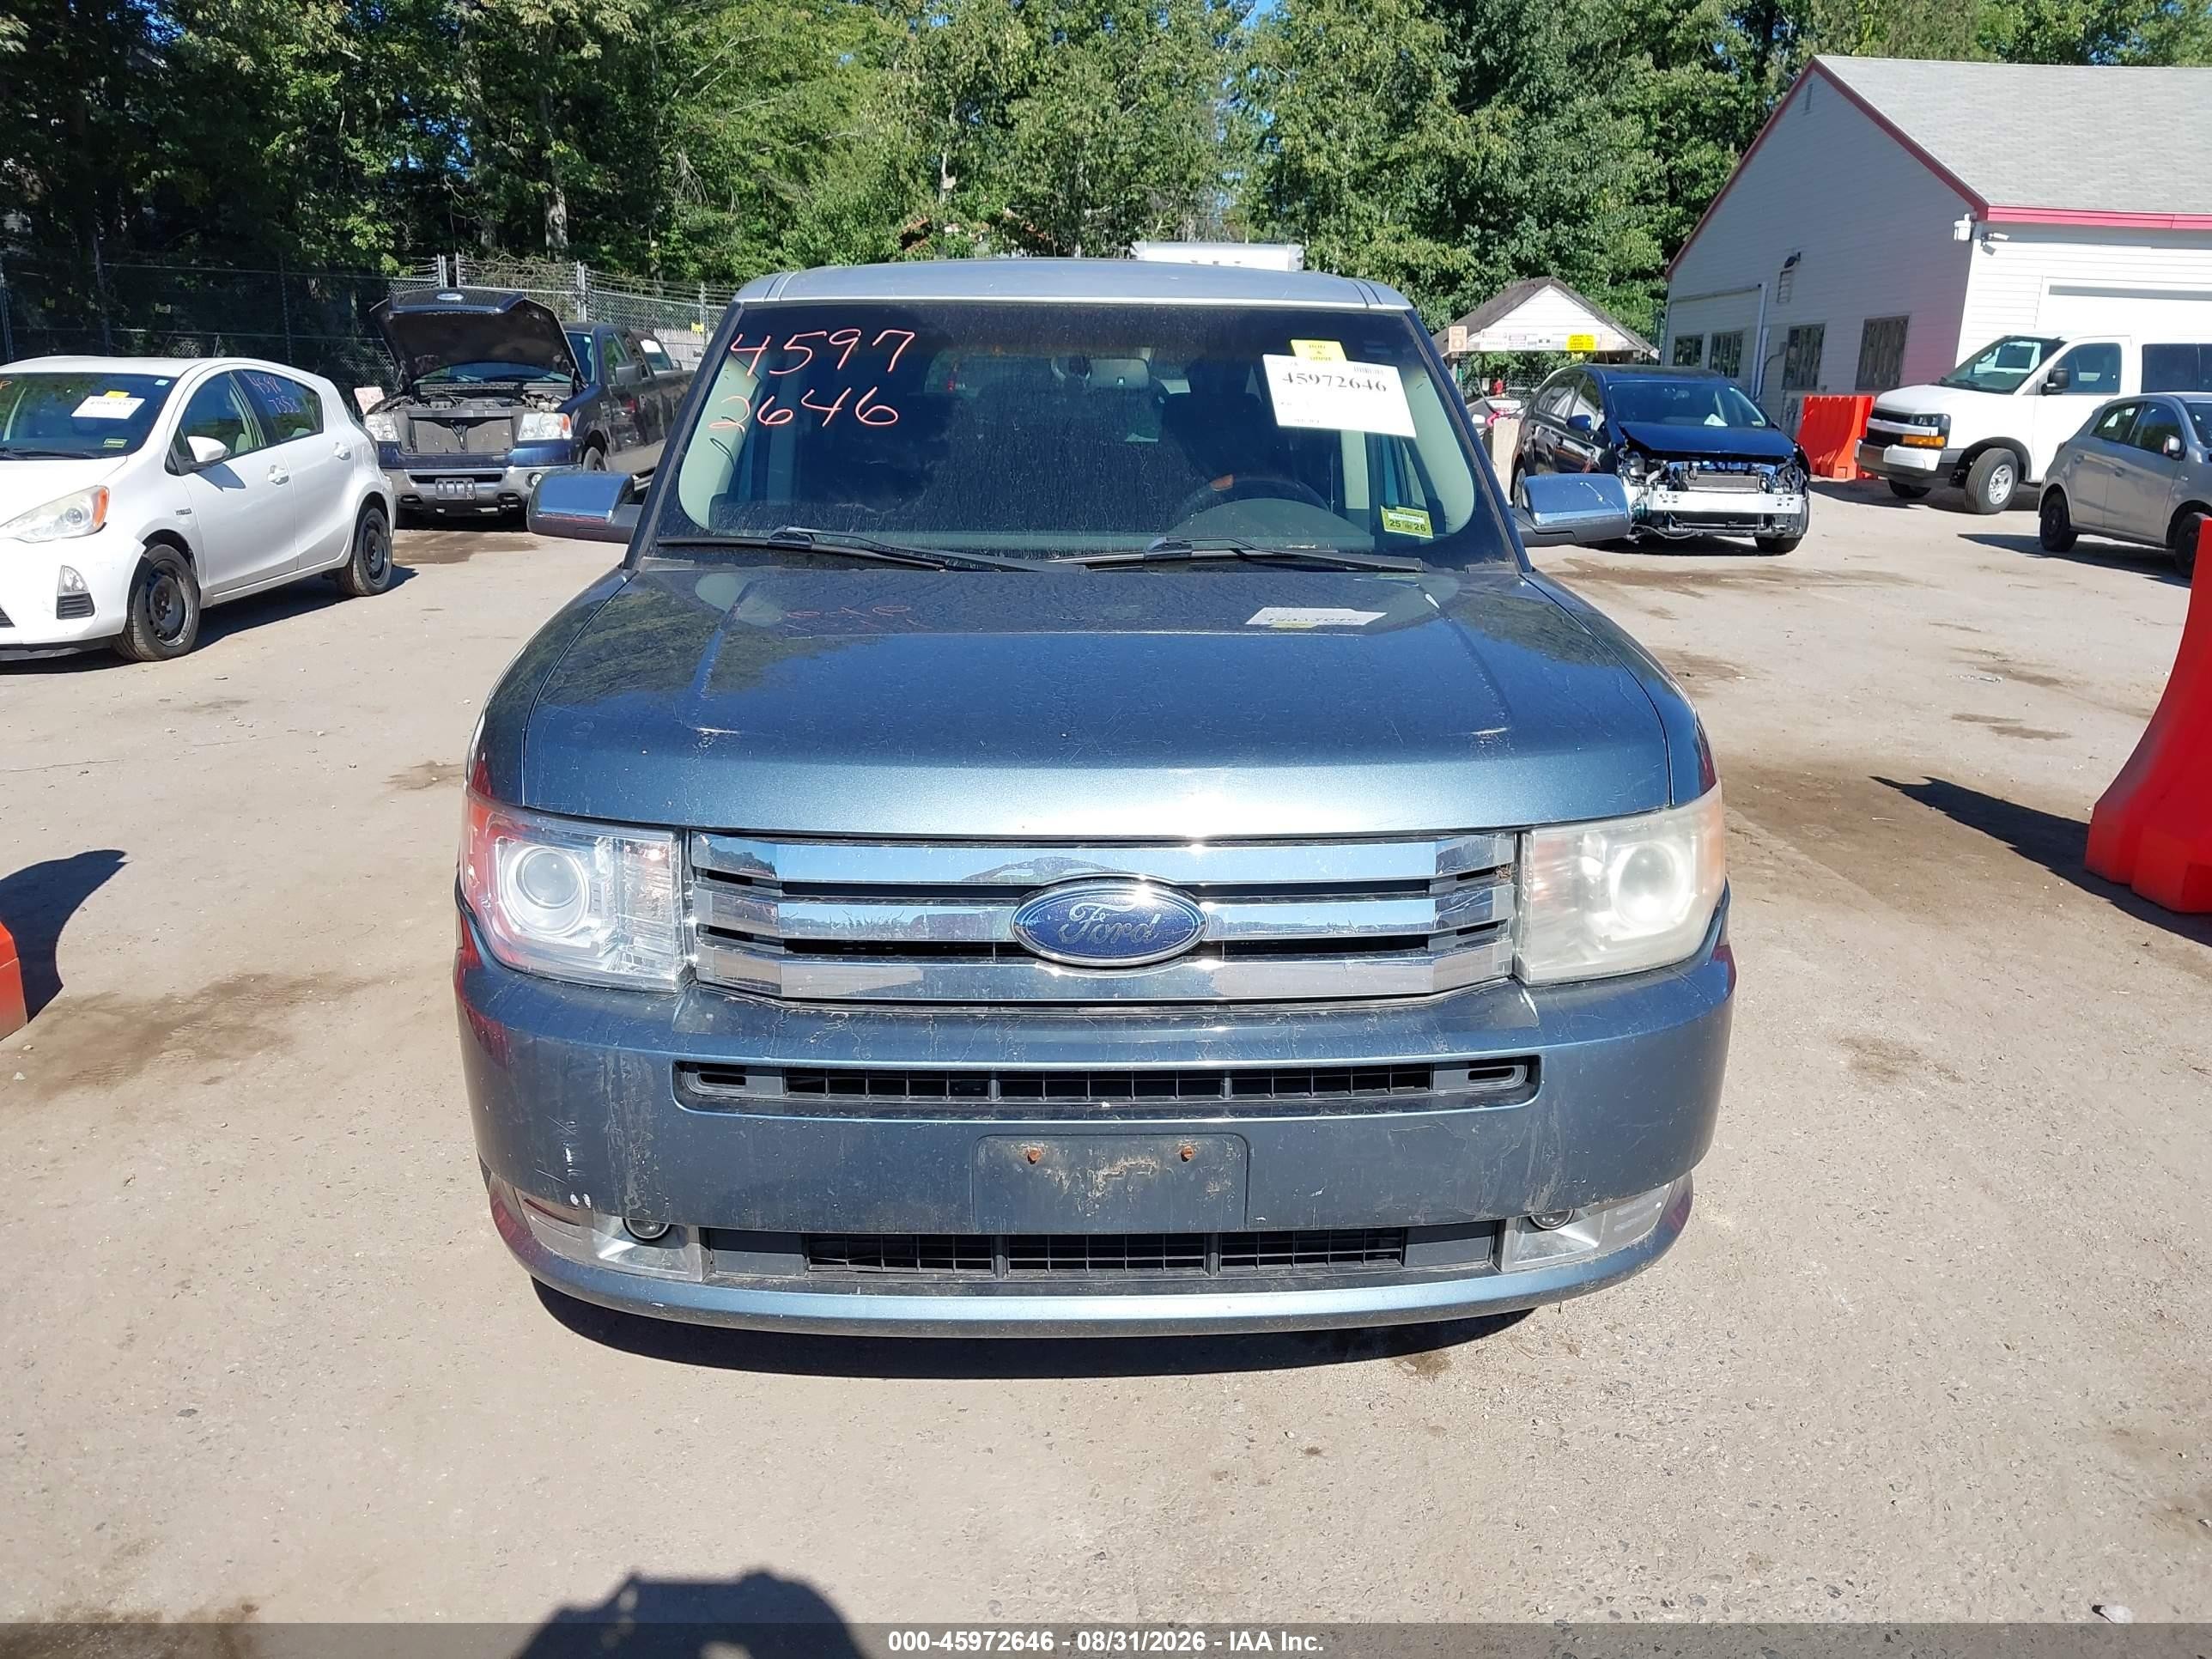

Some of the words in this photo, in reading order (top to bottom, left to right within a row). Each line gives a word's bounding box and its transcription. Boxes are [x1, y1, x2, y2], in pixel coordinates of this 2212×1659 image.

[729, 328, 916, 377] 4597
[1281, 372, 1388, 392] 45972646
[708, 385, 900, 434] 2646
[1389, 519, 1401, 528] 25
[1413, 523, 1427, 532] 26
[1056, 901, 1163, 945] Ford
